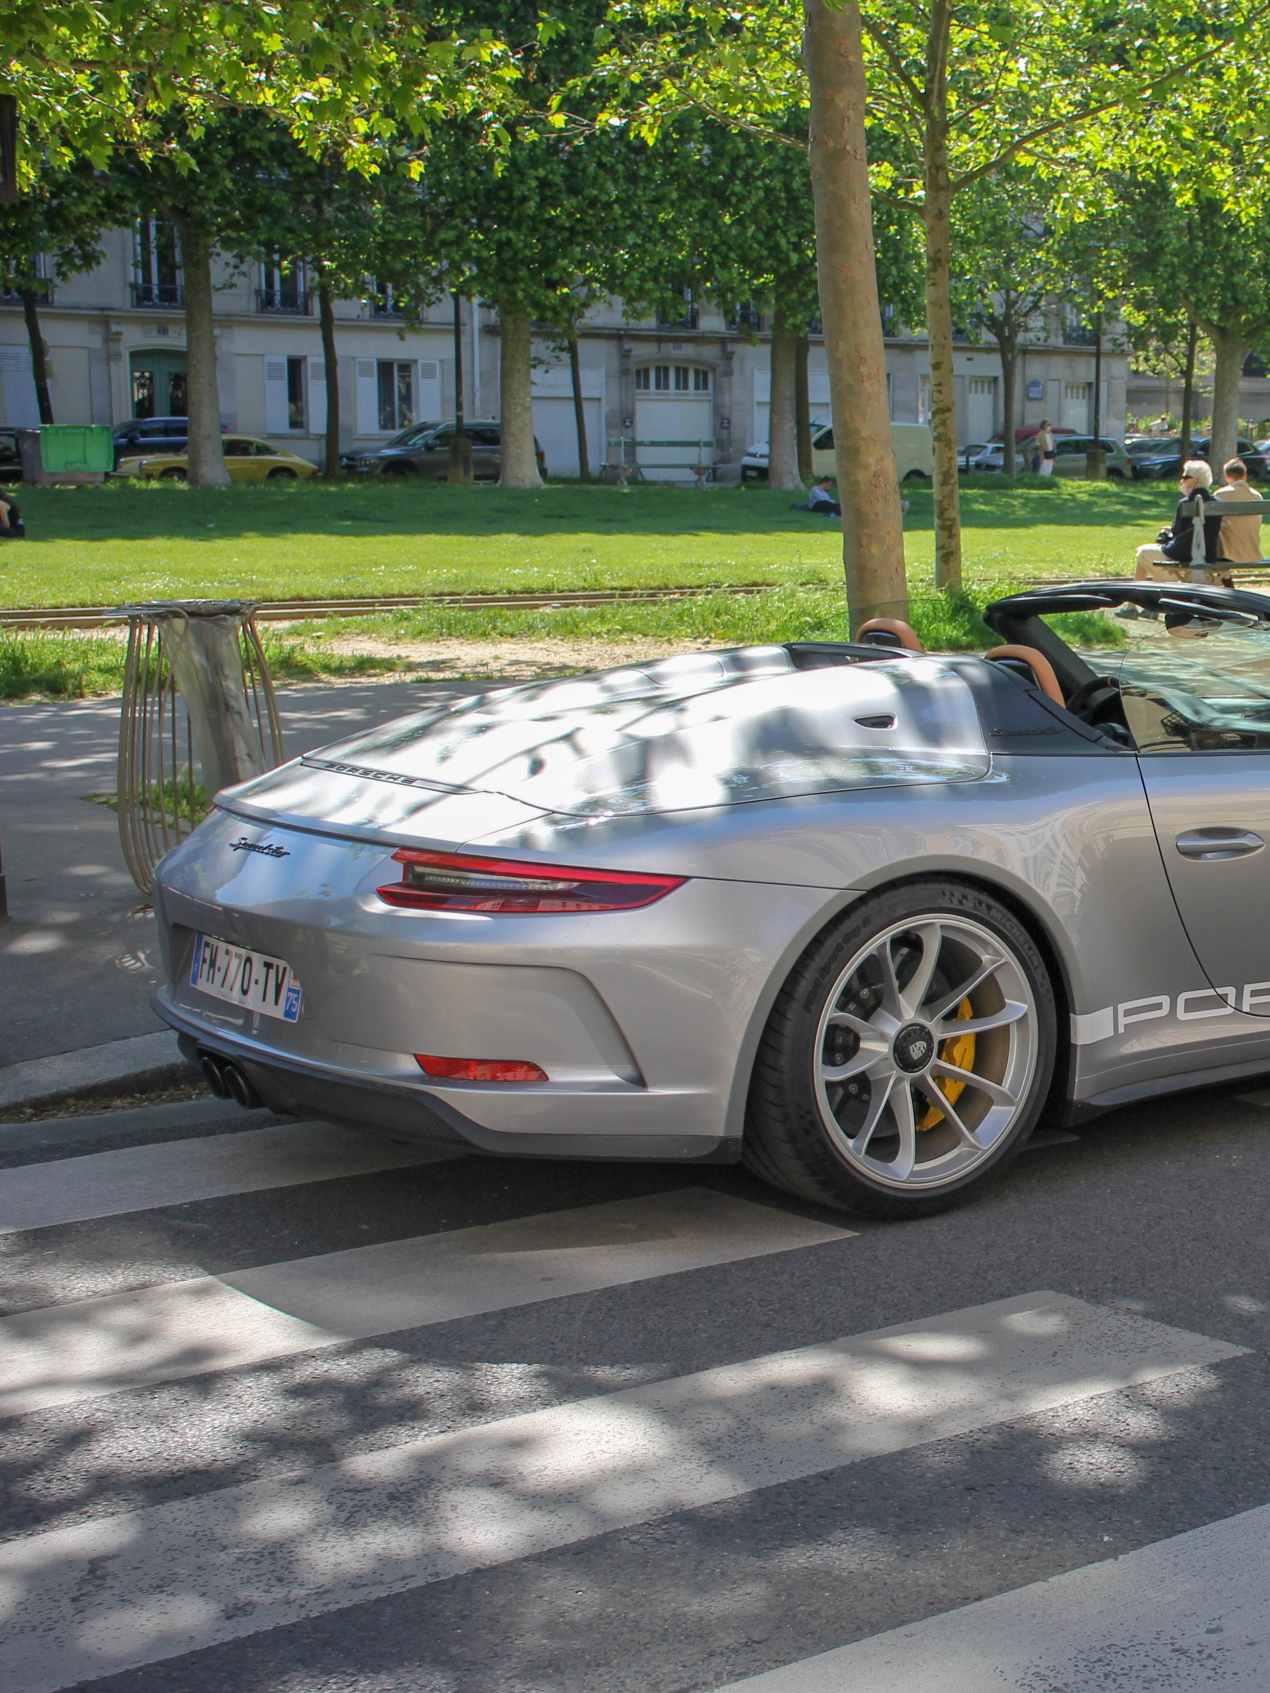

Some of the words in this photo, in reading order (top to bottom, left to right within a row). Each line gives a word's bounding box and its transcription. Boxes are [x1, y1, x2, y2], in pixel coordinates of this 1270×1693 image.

[325, 763, 418, 785] PORSCHE
[990, 907, 1040, 968] MICHELIN
[199, 940, 288, 1007] FH-770-TV
[285, 991, 299, 1013] 75
